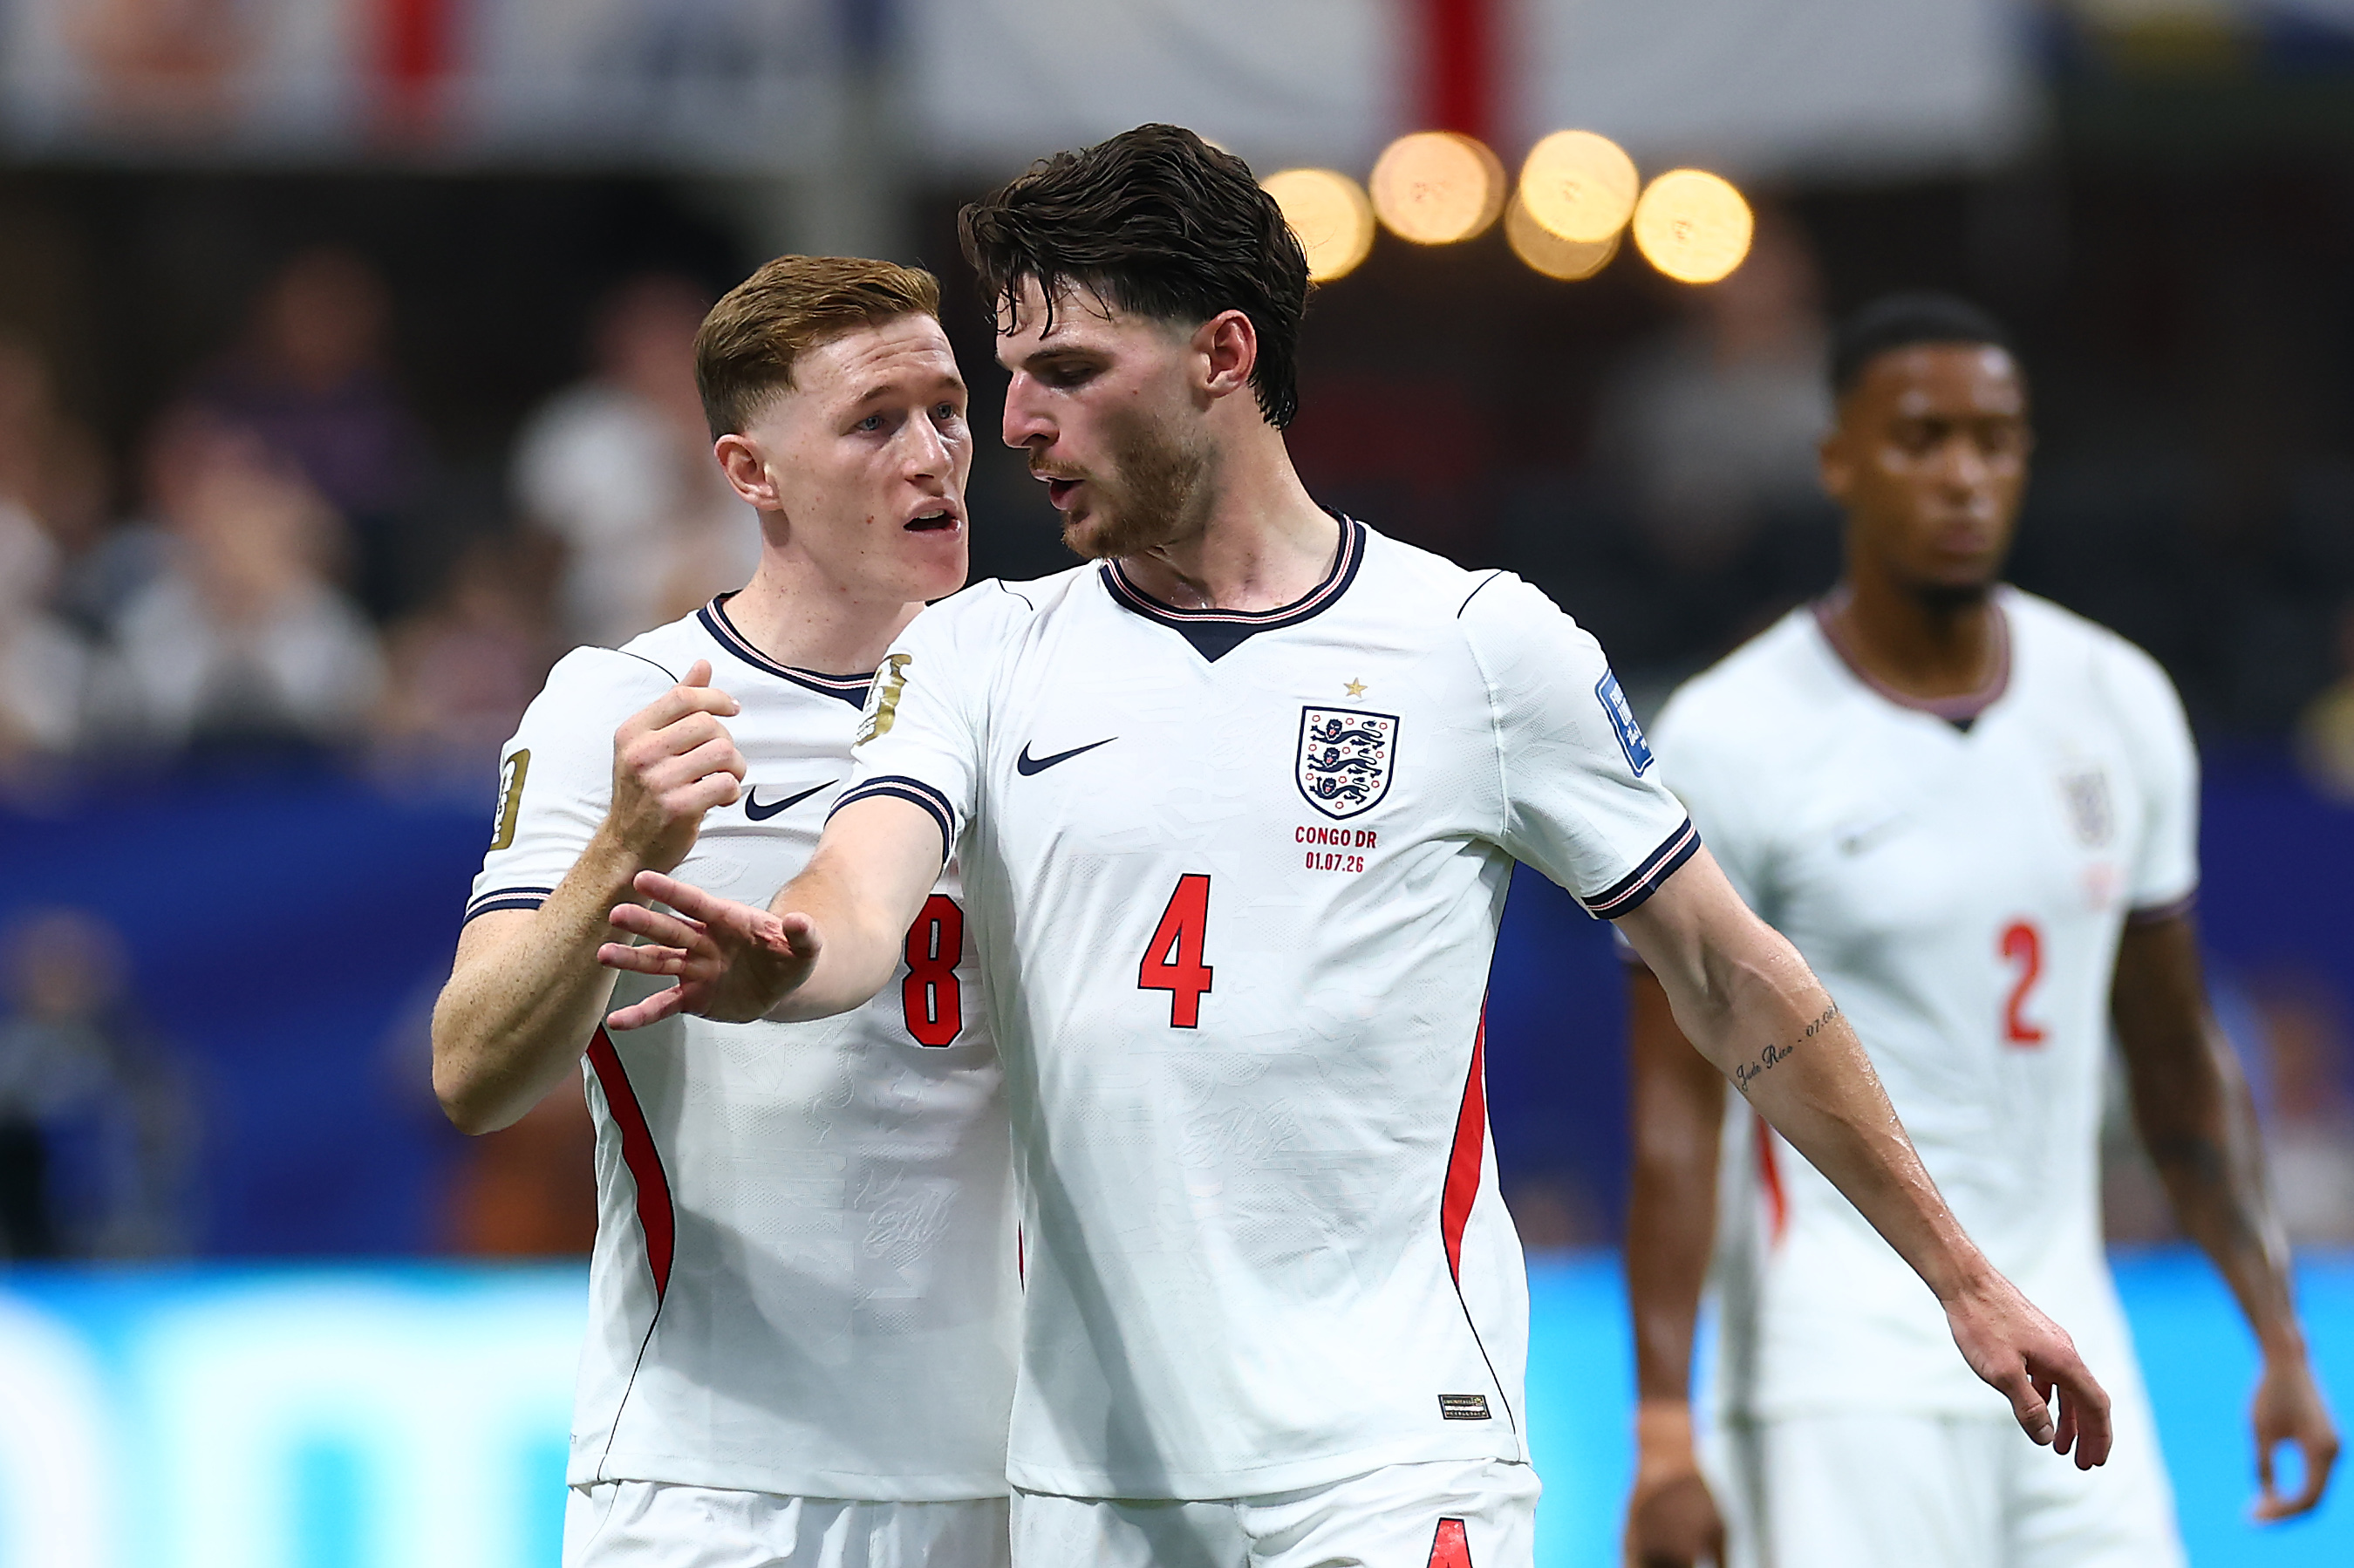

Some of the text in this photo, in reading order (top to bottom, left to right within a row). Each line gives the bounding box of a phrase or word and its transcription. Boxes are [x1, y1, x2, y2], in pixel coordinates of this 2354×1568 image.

[1295, 826, 1377, 849] CONGO DR
[1306, 851, 1364, 873] 01.07.26
[902, 894, 964, 1047] 8
[1137, 873, 1213, 1029] 4
[1997, 919, 2045, 1046] 2
